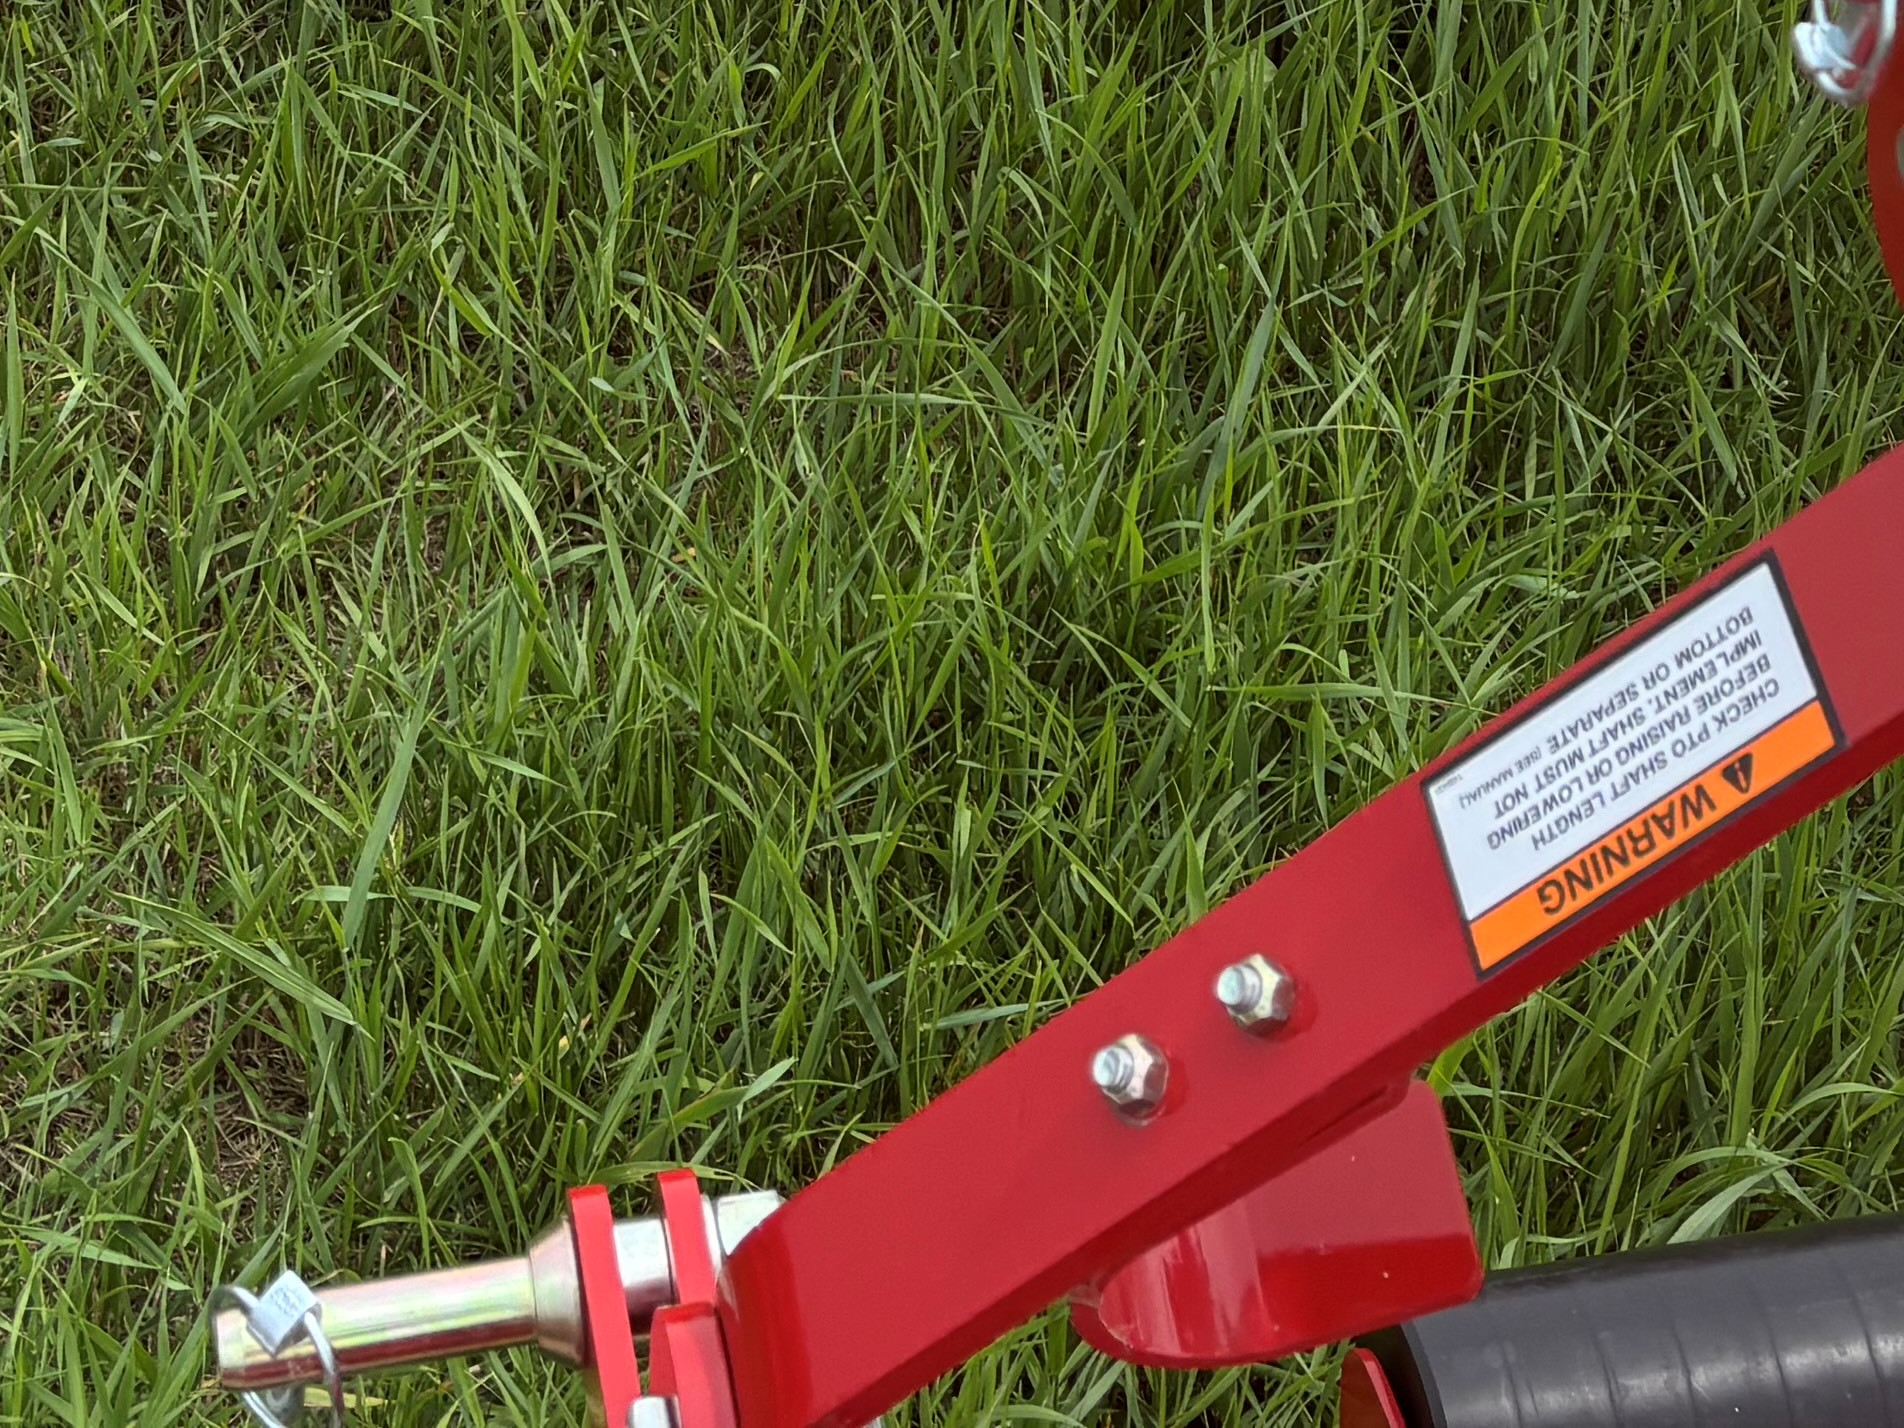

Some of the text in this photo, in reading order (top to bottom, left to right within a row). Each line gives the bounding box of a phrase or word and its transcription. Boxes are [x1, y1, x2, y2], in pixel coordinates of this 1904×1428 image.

[1673, 606, 1753, 669] BOTTOM
[1641, 662, 1670, 690] OR
[1693, 652, 1771, 715] BEFORE
[1546, 682, 1639, 754] SEPARATE
[1588, 706, 1646, 757] SHAFT
[1614, 705, 1691, 765] RAISING
[1530, 677, 1779, 851] CHECK PTO SHAFT LENGTH
[1534, 746, 1585, 792] MUST
[1585, 757, 1612, 785] OR
[1486, 776, 1583, 850] LOWERING
[1494, 782, 1529, 818] NOT
[1536, 783, 1716, 914] WARNING
